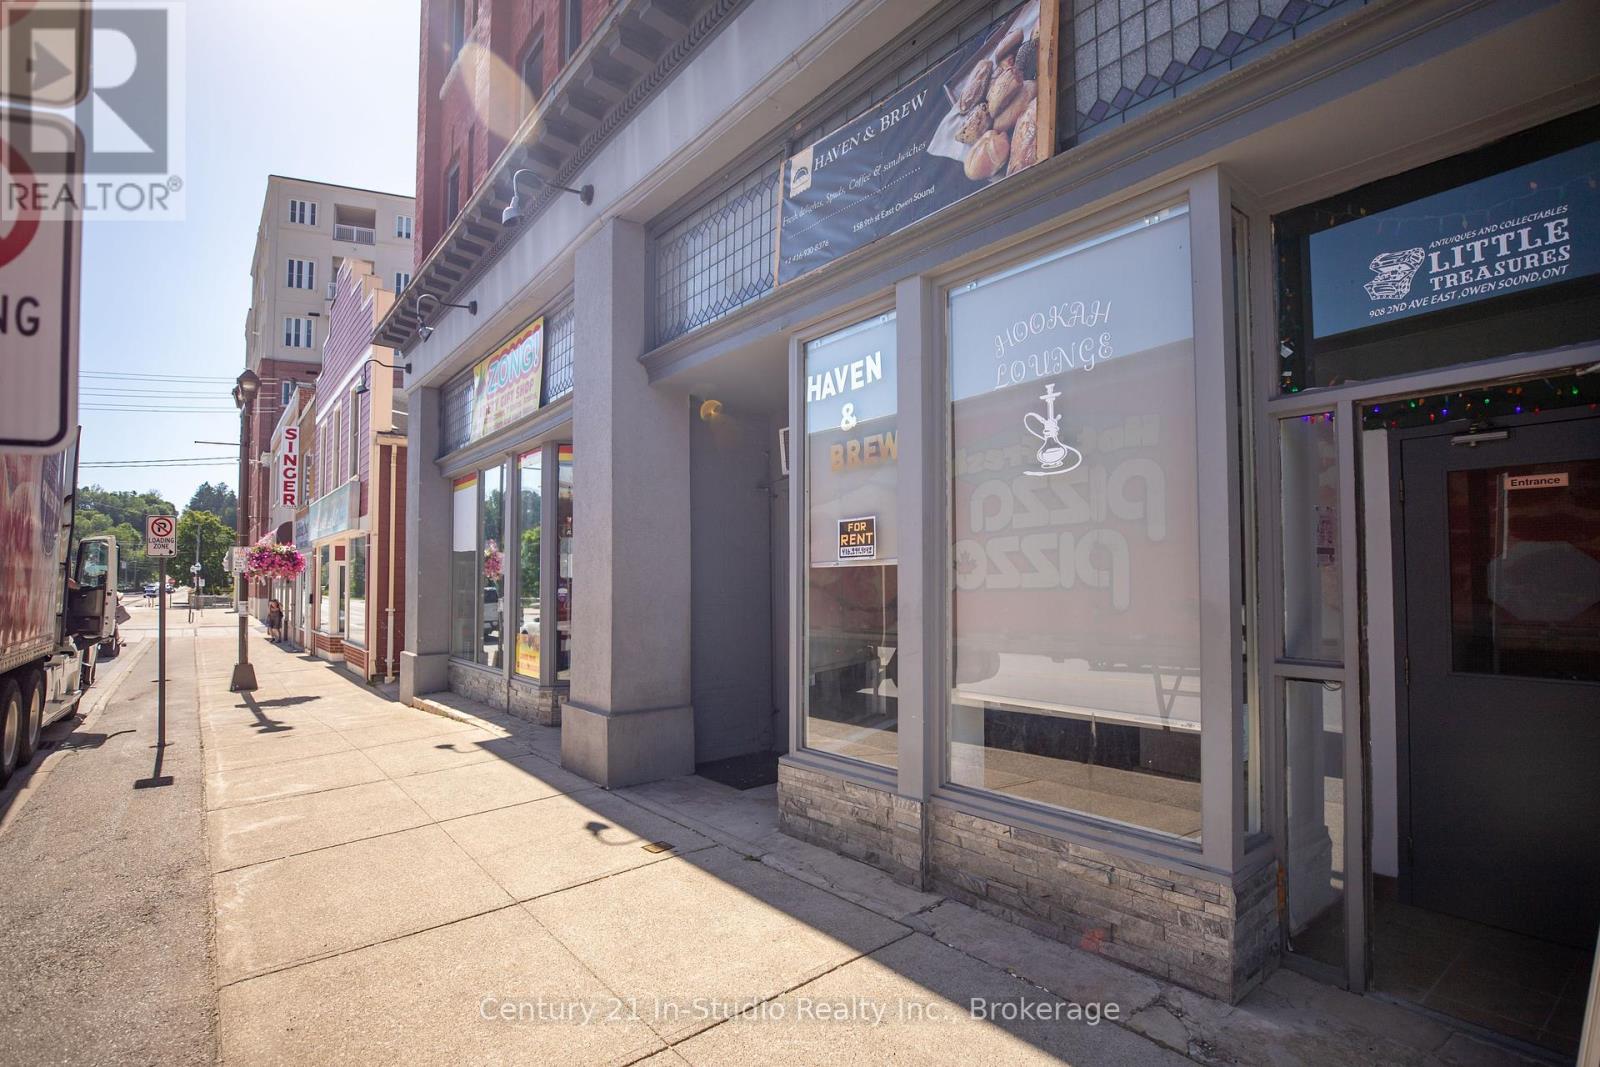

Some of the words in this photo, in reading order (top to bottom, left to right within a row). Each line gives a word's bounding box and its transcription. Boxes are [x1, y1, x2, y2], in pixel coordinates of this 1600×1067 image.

[813, 132, 861, 171] HAVEN
[863, 126, 876, 142] &
[880, 89, 928, 132] BREW
[881, 207, 895, 219] East
[895, 199, 913, 212] Owen
[913, 185, 936, 202] Sound
[1478, 224, 1498, 236] AND
[1499, 204, 1569, 231] COLLECTABLES
[1428, 218, 1570, 274] LITTLE
[1430, 245, 1571, 291] TREASURES
[1369, 307, 1385, 318] 908
[1386, 302, 1407, 315] 2ND
[1408, 296, 1430, 310] AVE
[1431, 290, 1457, 305] EAST
[994, 299, 1112, 359] HOOKAH
[807, 351, 882, 403] HAVEN
[993, 331, 1113, 391] LOUNGE
[841, 402, 856, 431] &
[282, 427, 298, 506] SINGER
[830, 430, 898, 473] BREW
[1511, 477, 1561, 487] Entrance
[840, 532, 874, 546] RENT
[847, 521, 867, 532] FOR
